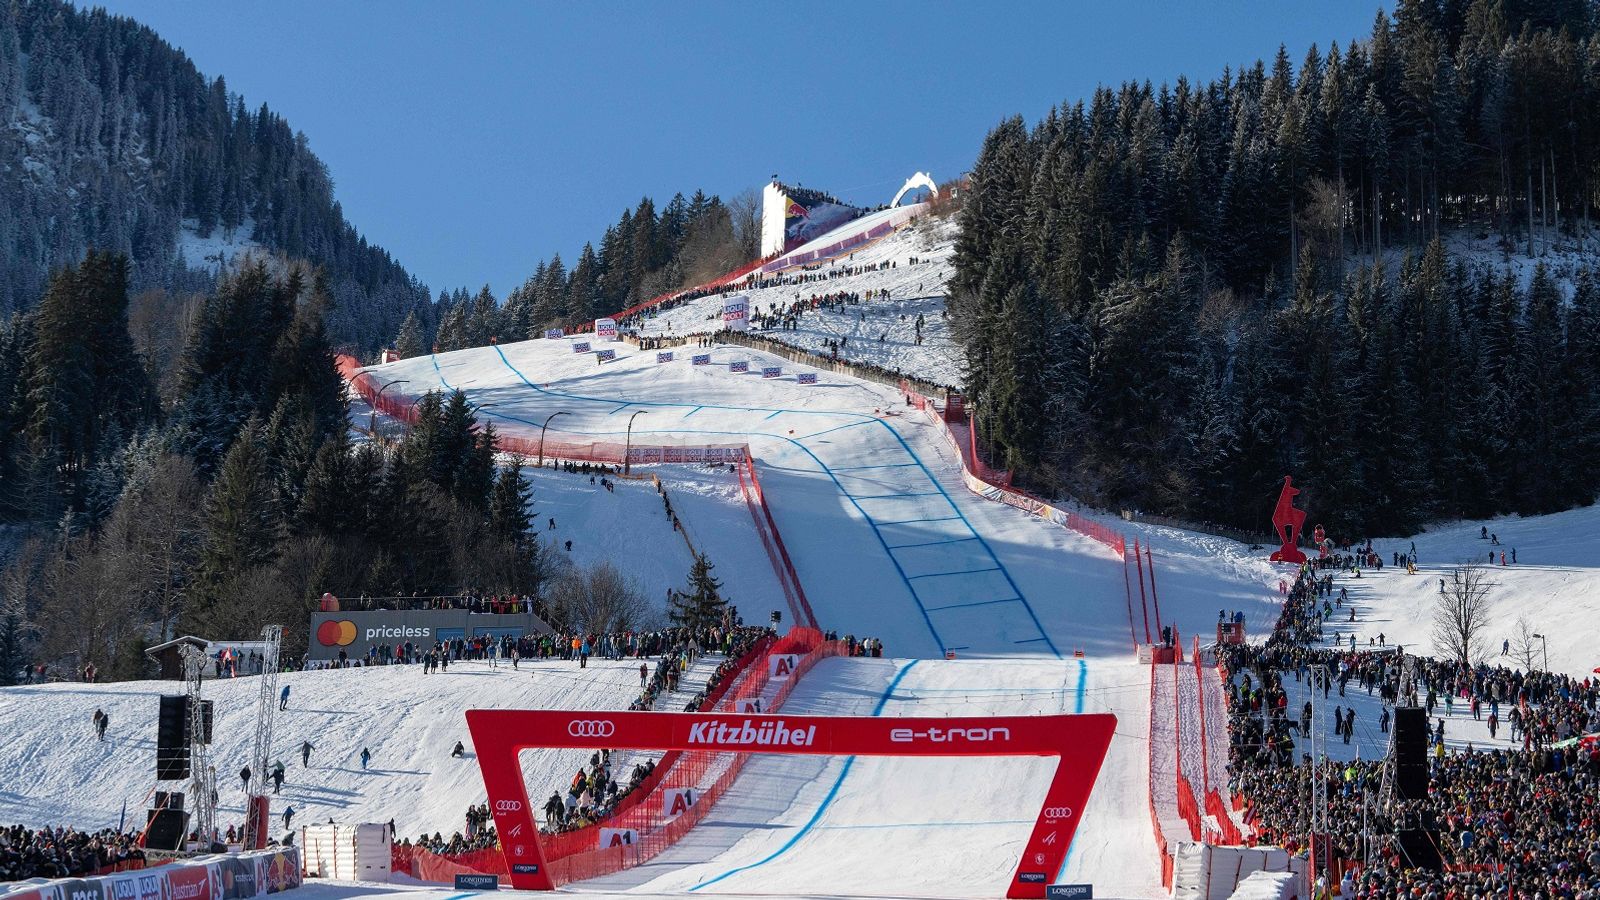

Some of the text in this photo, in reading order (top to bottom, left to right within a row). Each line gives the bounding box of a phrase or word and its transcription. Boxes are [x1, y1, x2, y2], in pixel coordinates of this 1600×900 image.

[724, 304, 743, 312] LIQUI
[724, 312, 743, 320] MOLY
[366, 625, 430, 641] priceless
[775, 656, 793, 676] A1
[688, 719, 817, 746] Kitzbühel
[890, 727, 1010, 742] e-tron
[670, 789, 692, 815] A1
[610, 831, 631, 847] A1
[118, 882, 134, 898] LIQUI
[140, 877, 158, 893] LIQUI
[173, 881, 198, 900] Austrian
